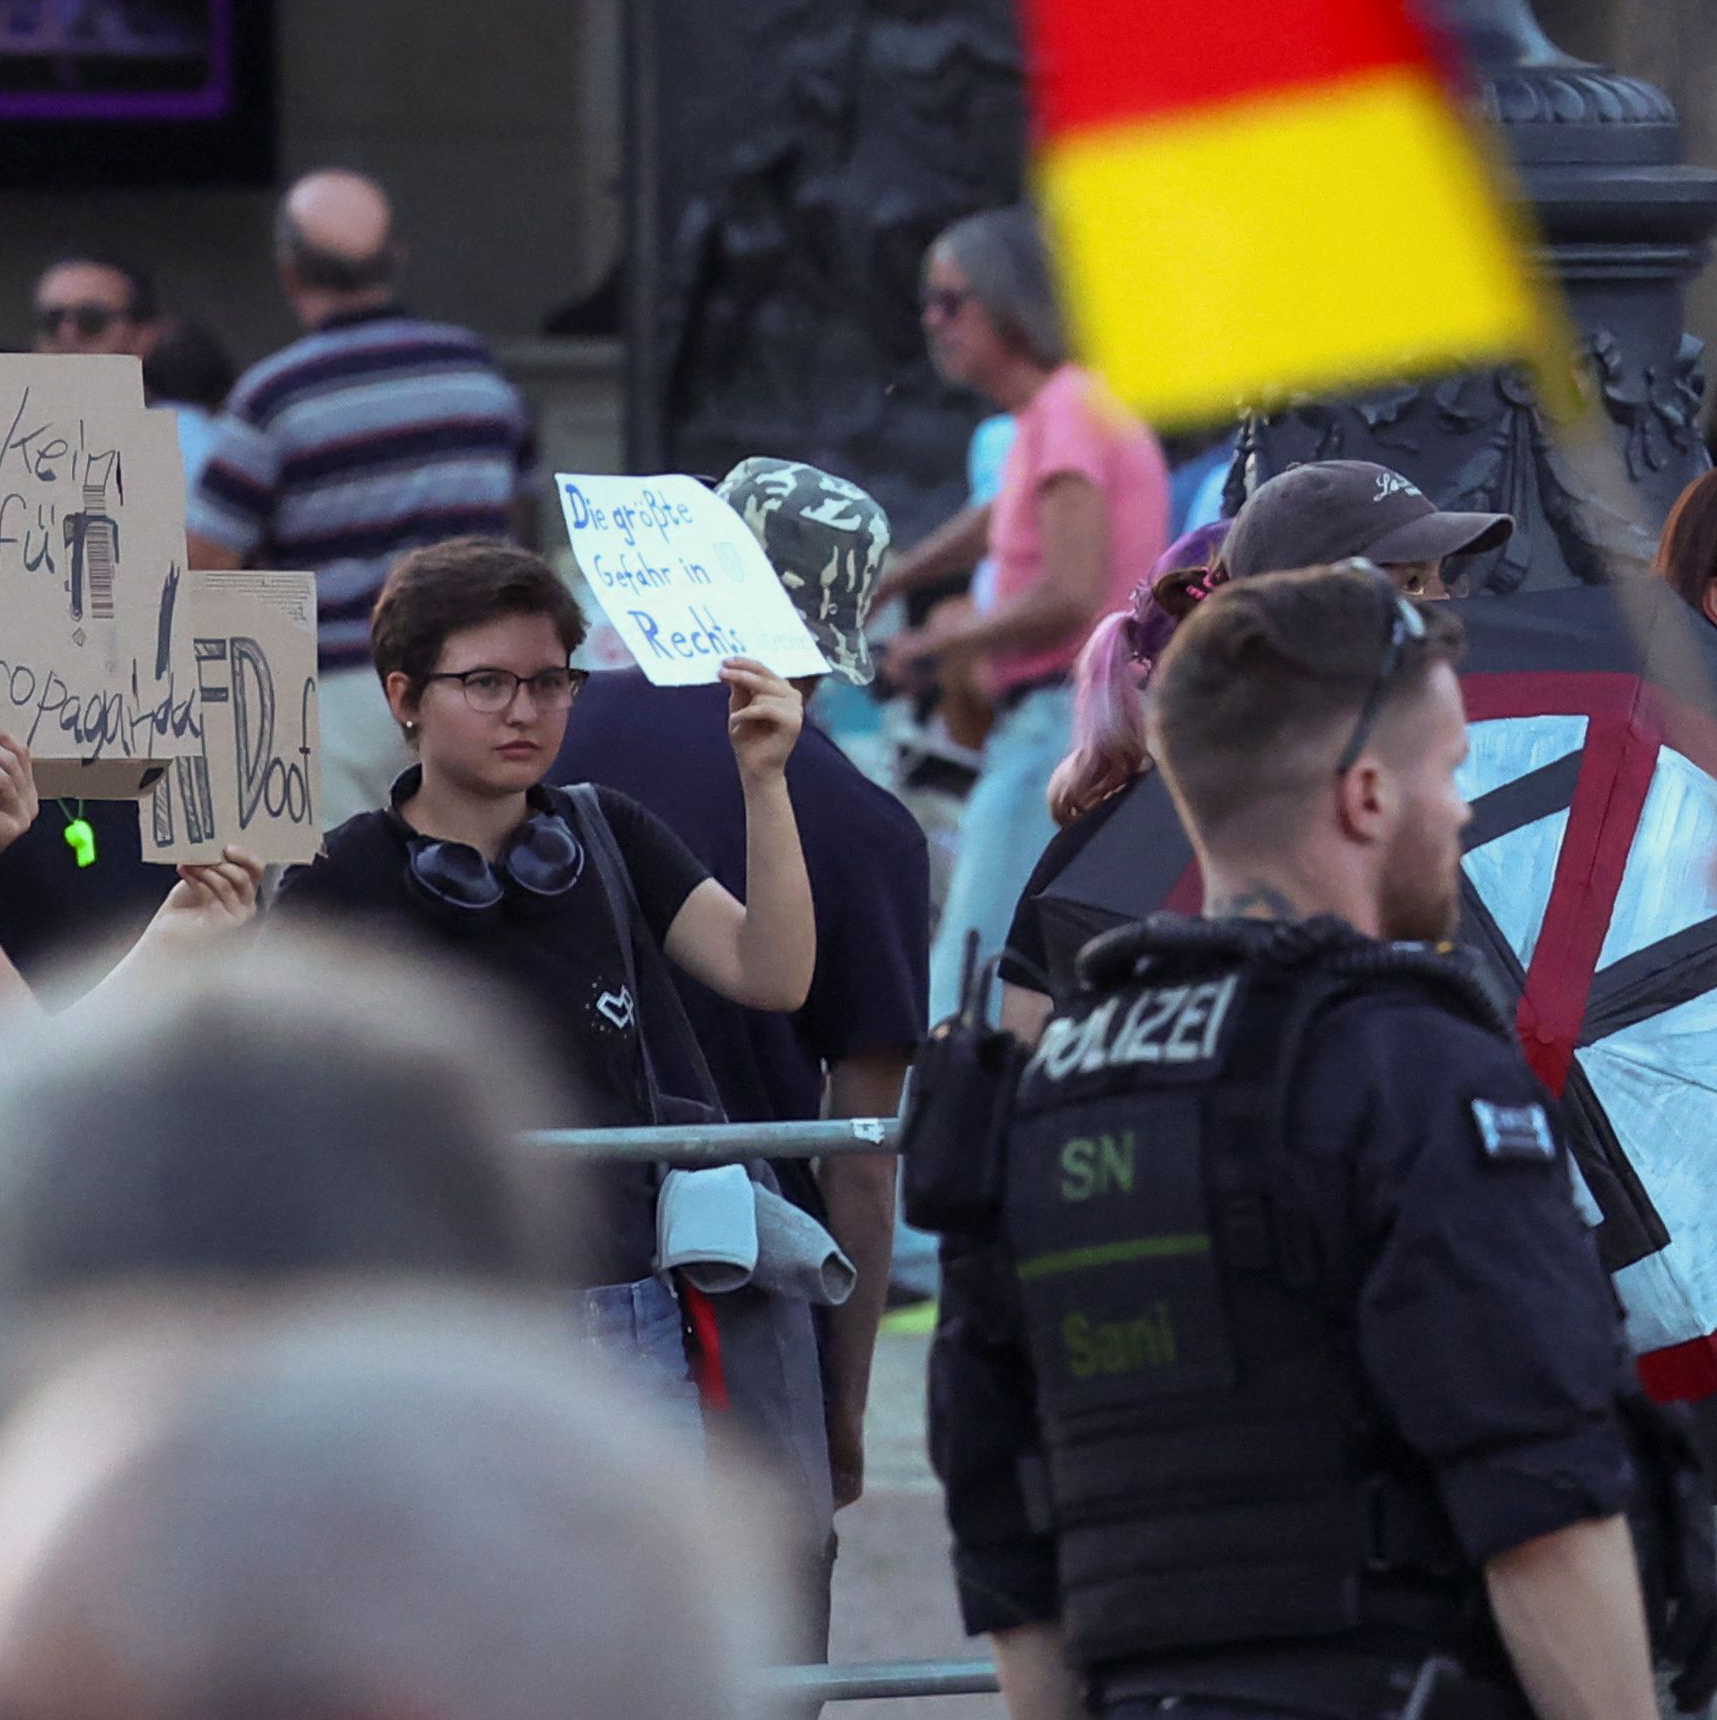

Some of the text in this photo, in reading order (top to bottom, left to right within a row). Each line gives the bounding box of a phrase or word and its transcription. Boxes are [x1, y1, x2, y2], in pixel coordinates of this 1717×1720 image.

[565, 483, 610, 531] Die
[593, 551, 713, 597] Gefahr in
[1017, 973, 1240, 1099] POLIZEI
[1061, 1132, 1136, 1203] SN
